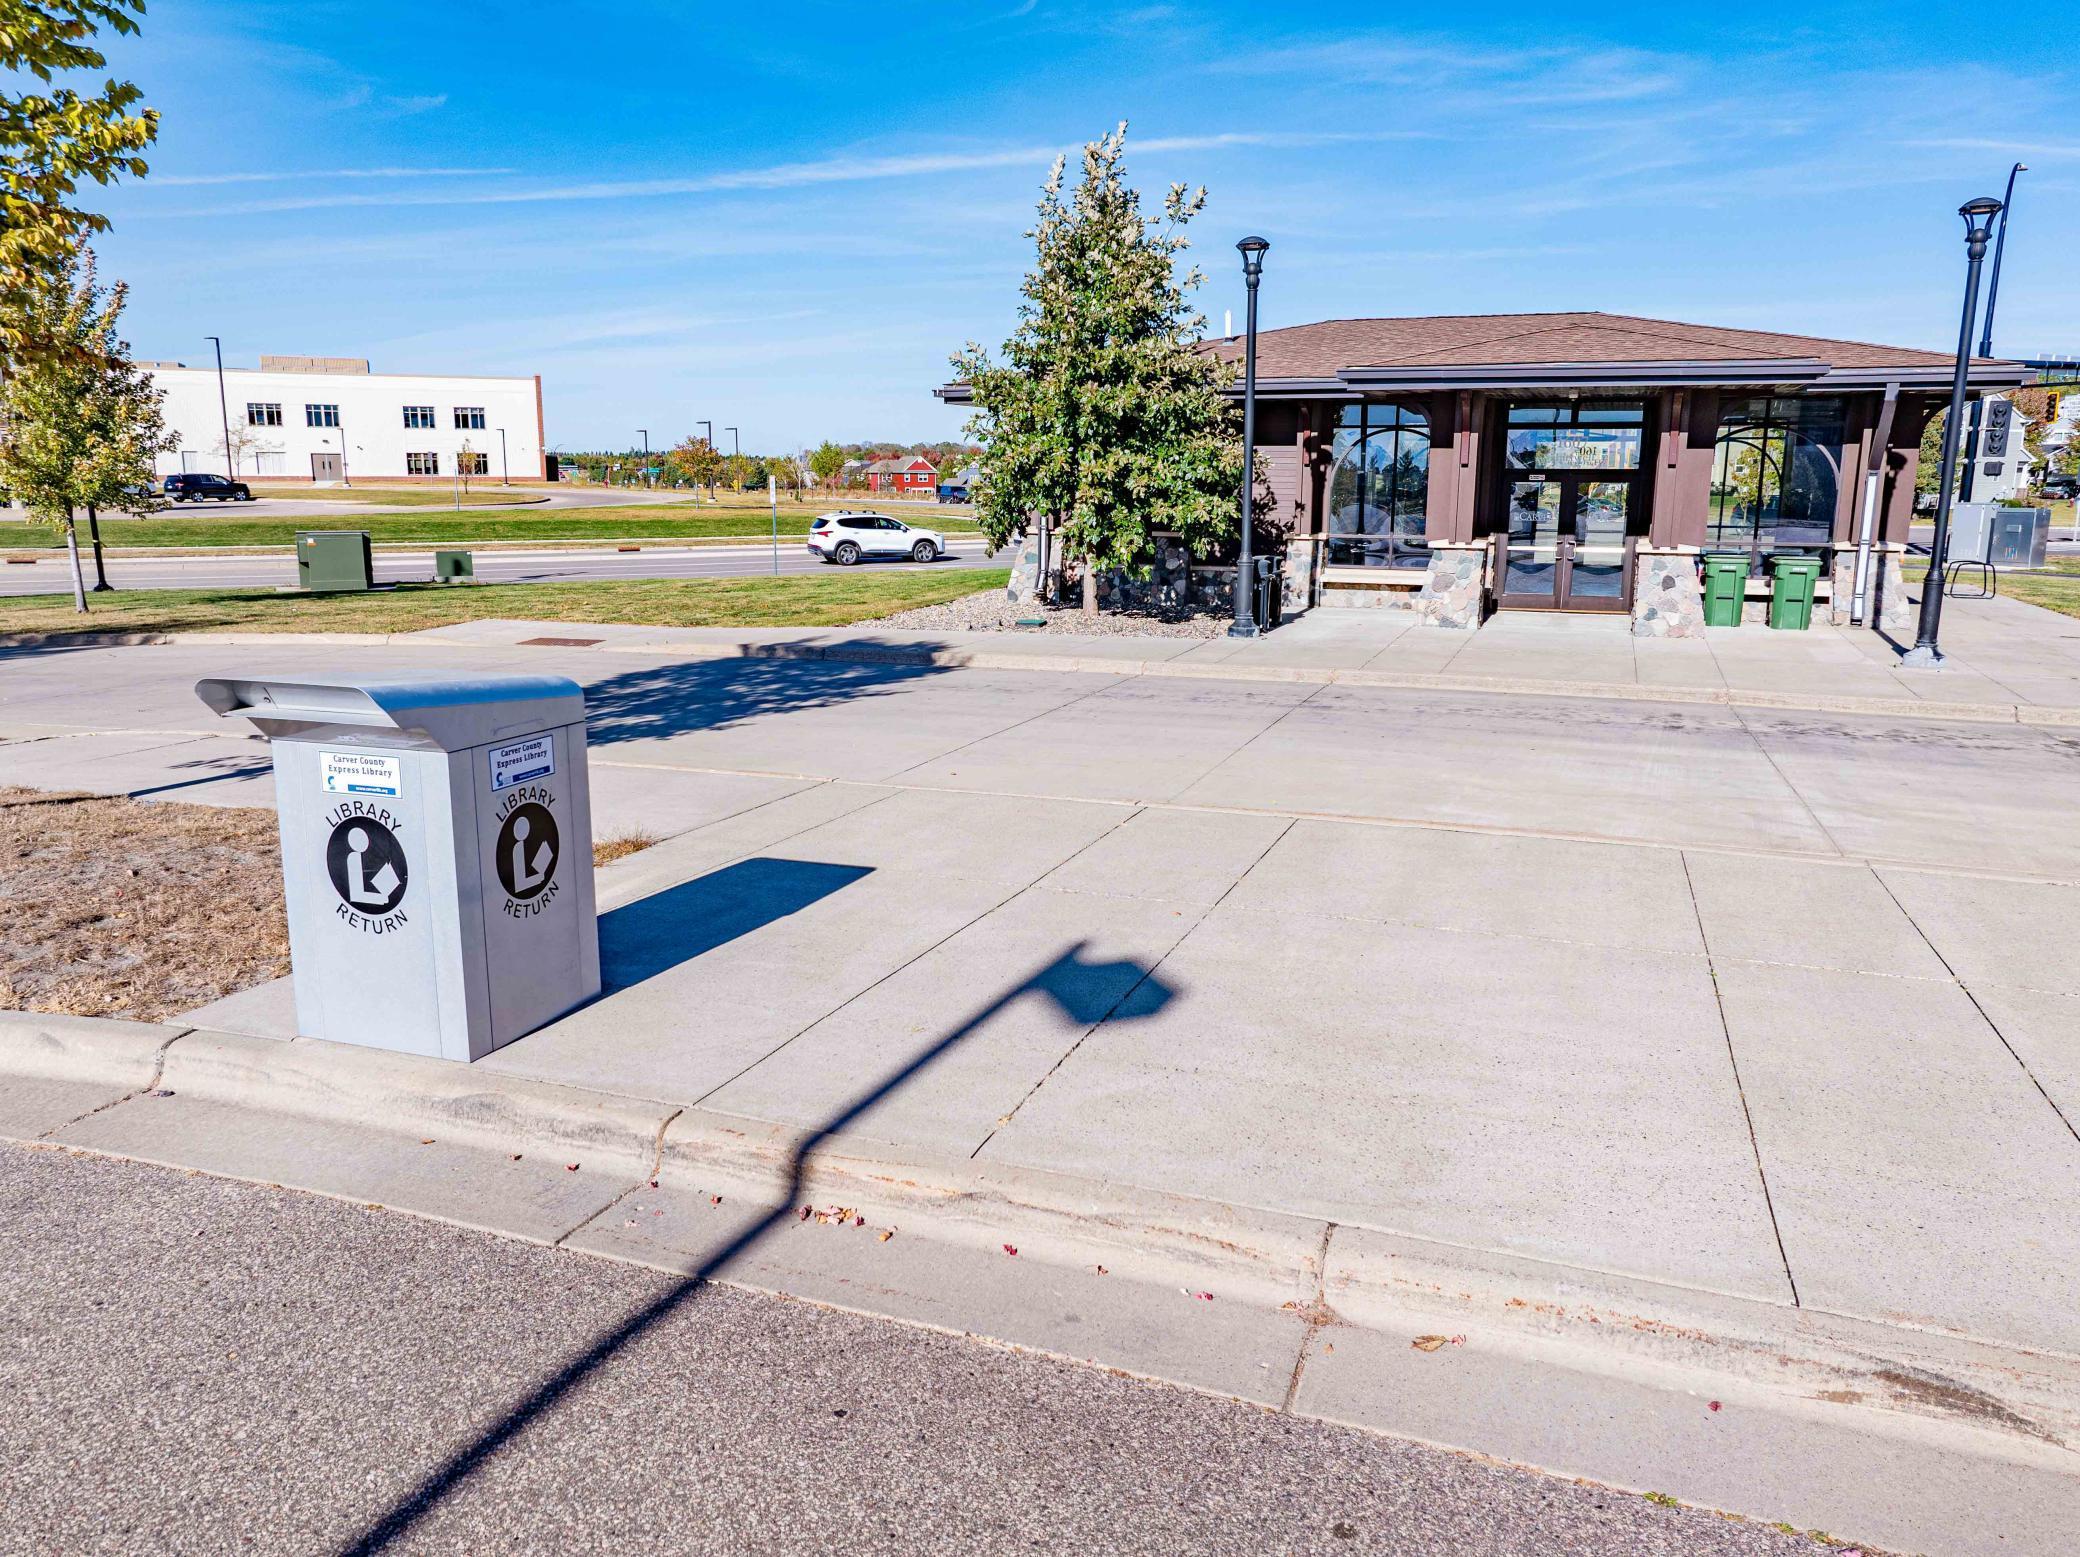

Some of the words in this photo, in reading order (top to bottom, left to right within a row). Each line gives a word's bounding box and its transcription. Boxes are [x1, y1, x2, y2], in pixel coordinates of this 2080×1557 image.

[333, 755, 358, 764] Carver
[360, 757, 386, 767] County
[497, 757, 523, 768] Express
[524, 750, 548, 762] Library
[501, 747, 521, 757] Carver
[523, 741, 543, 751] County
[328, 765, 360, 774] Express
[362, 767, 393, 778] Library
[325, 800, 402, 832] LIBRARY
[495, 786, 556, 823] LIBRARY
[503, 881, 560, 919] RETURN
[336, 902, 408, 935] RETURN
